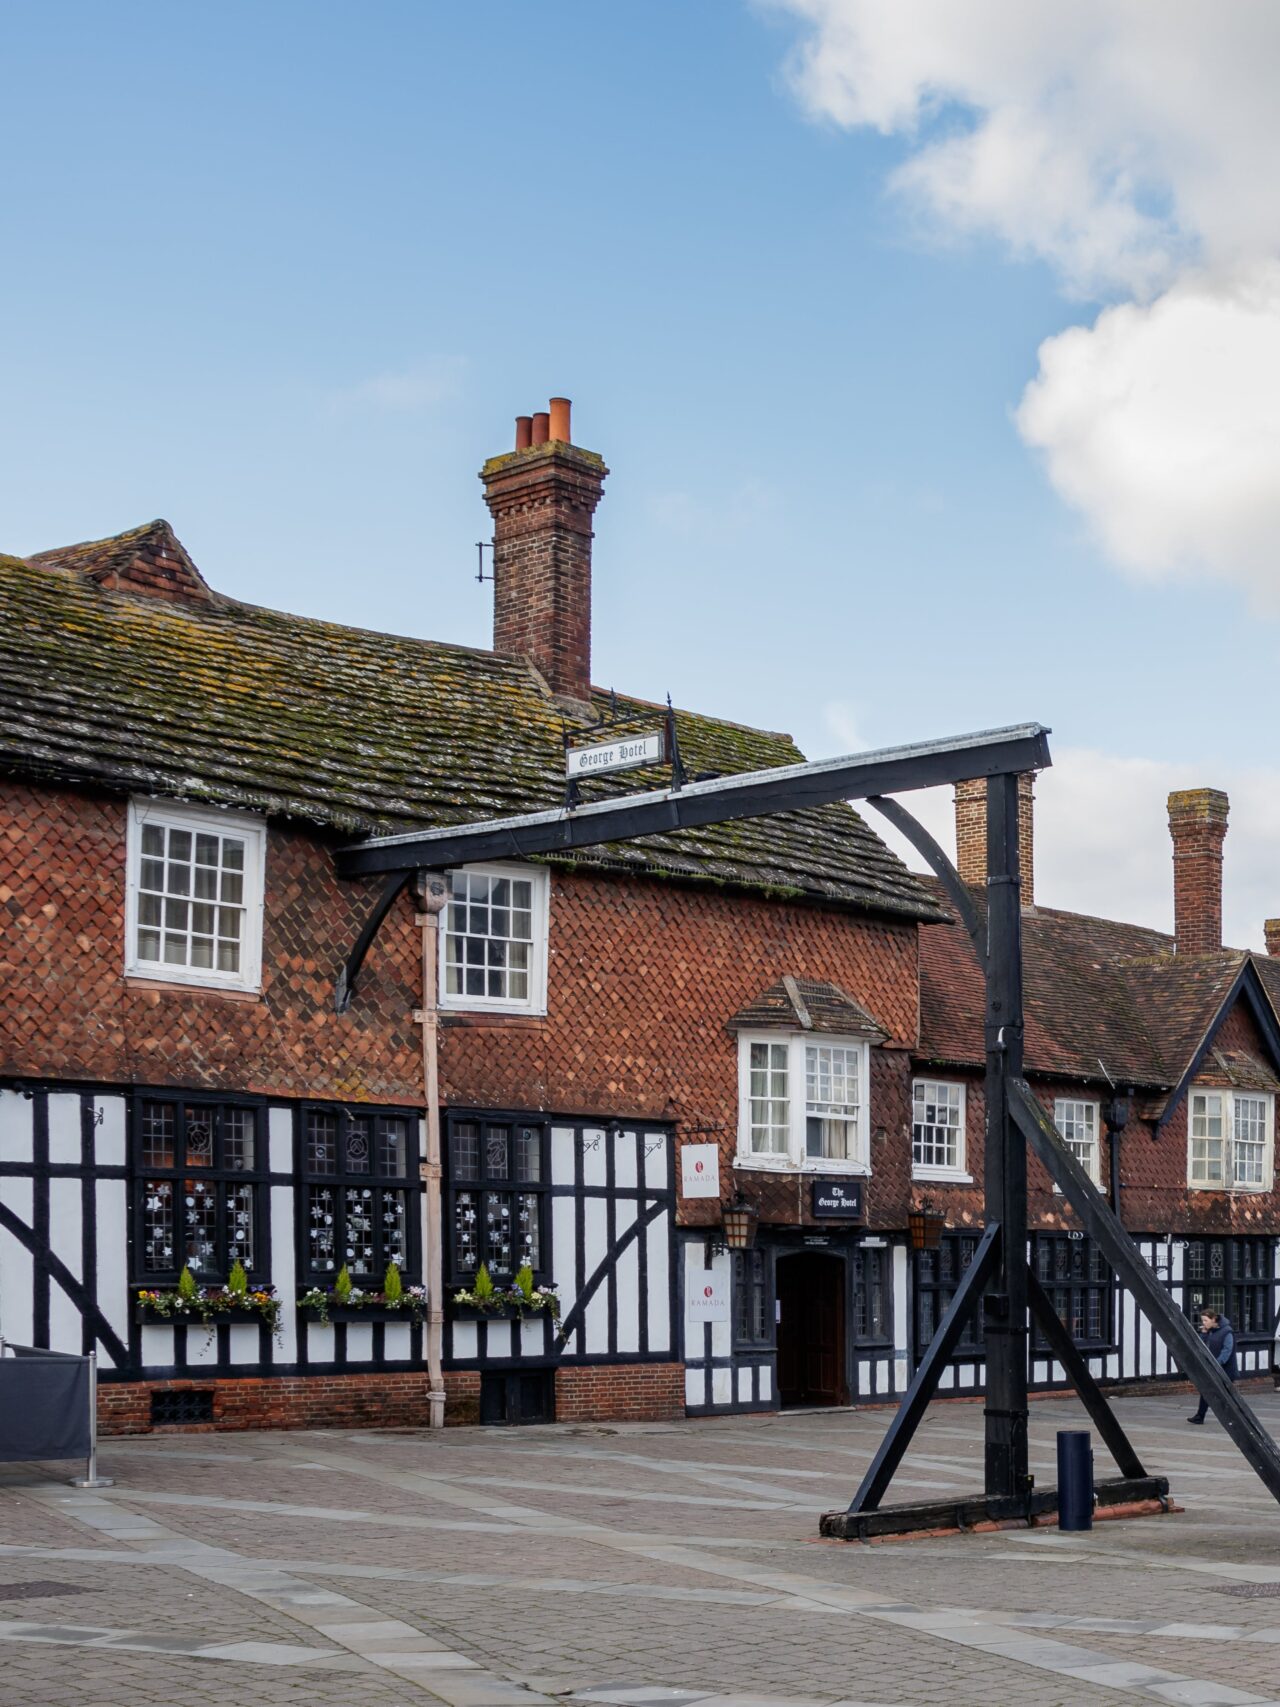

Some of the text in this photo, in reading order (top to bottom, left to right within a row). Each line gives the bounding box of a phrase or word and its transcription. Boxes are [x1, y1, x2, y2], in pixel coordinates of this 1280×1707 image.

[579, 741, 647, 767] George Hotel
[684, 1174, 716, 1182] RAMADA
[832, 1187, 844, 1196] The
[818, 1197, 857, 1208] George Hotel
